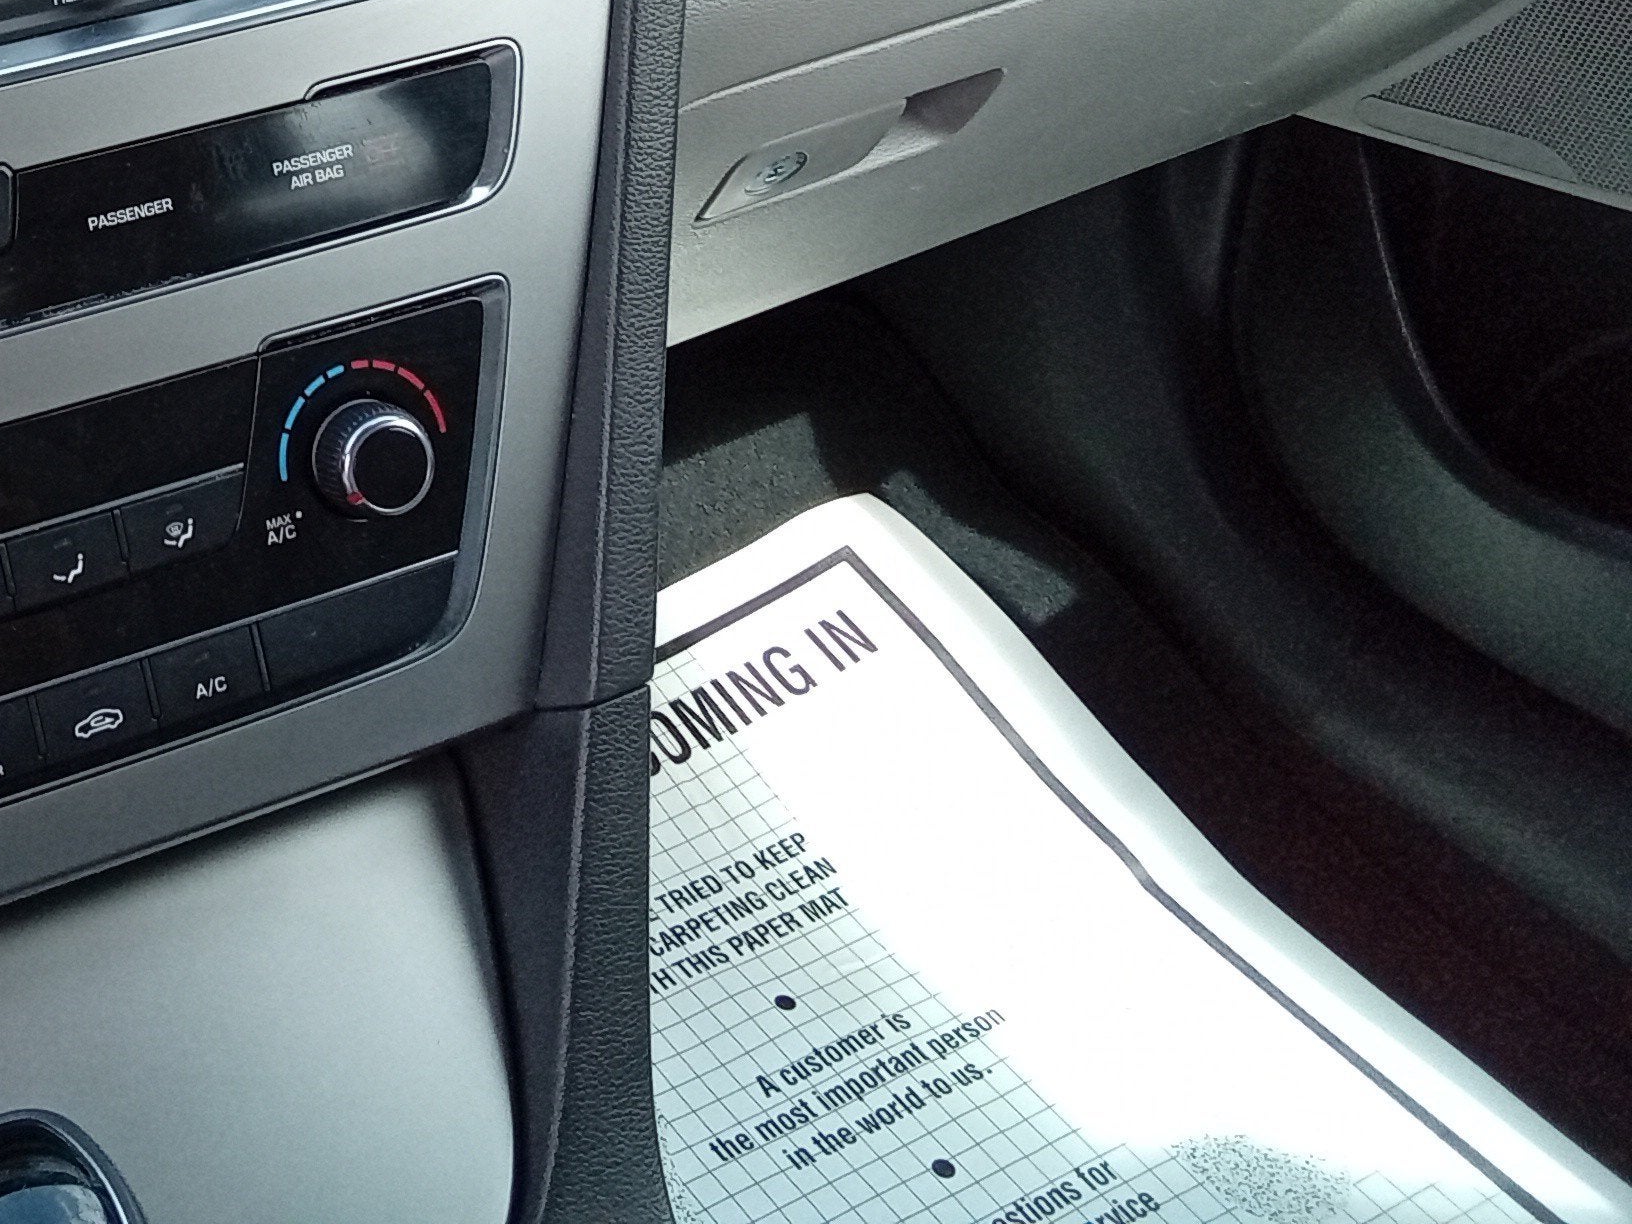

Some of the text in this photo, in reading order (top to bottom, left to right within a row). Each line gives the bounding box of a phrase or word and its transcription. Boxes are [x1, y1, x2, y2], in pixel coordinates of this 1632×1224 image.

[272, 144, 354, 176] PASSENGER
[290, 163, 345, 190] AIR BAG
[87, 197, 174, 231] PASSENGER
[266, 513, 293, 530] MAX
[267, 525, 297, 546] A/C
[195, 675, 228, 701] A/C
[650, 609, 879, 776] OMING IN
[654, 832, 807, 914] TRIED TO KEEP
[649, 856, 838, 957] CARPETING CLEAN
[670, 944, 730, 979] THIS
[726, 911, 804, 957] PAPER
[797, 886, 850, 923] MAT
[755, 1012, 912, 1098] A customer is
[709, 1008, 1006, 1162] the most important person
[782, 1060, 995, 1170] in the world to us.
[1074, 1160, 1118, 1191] for
